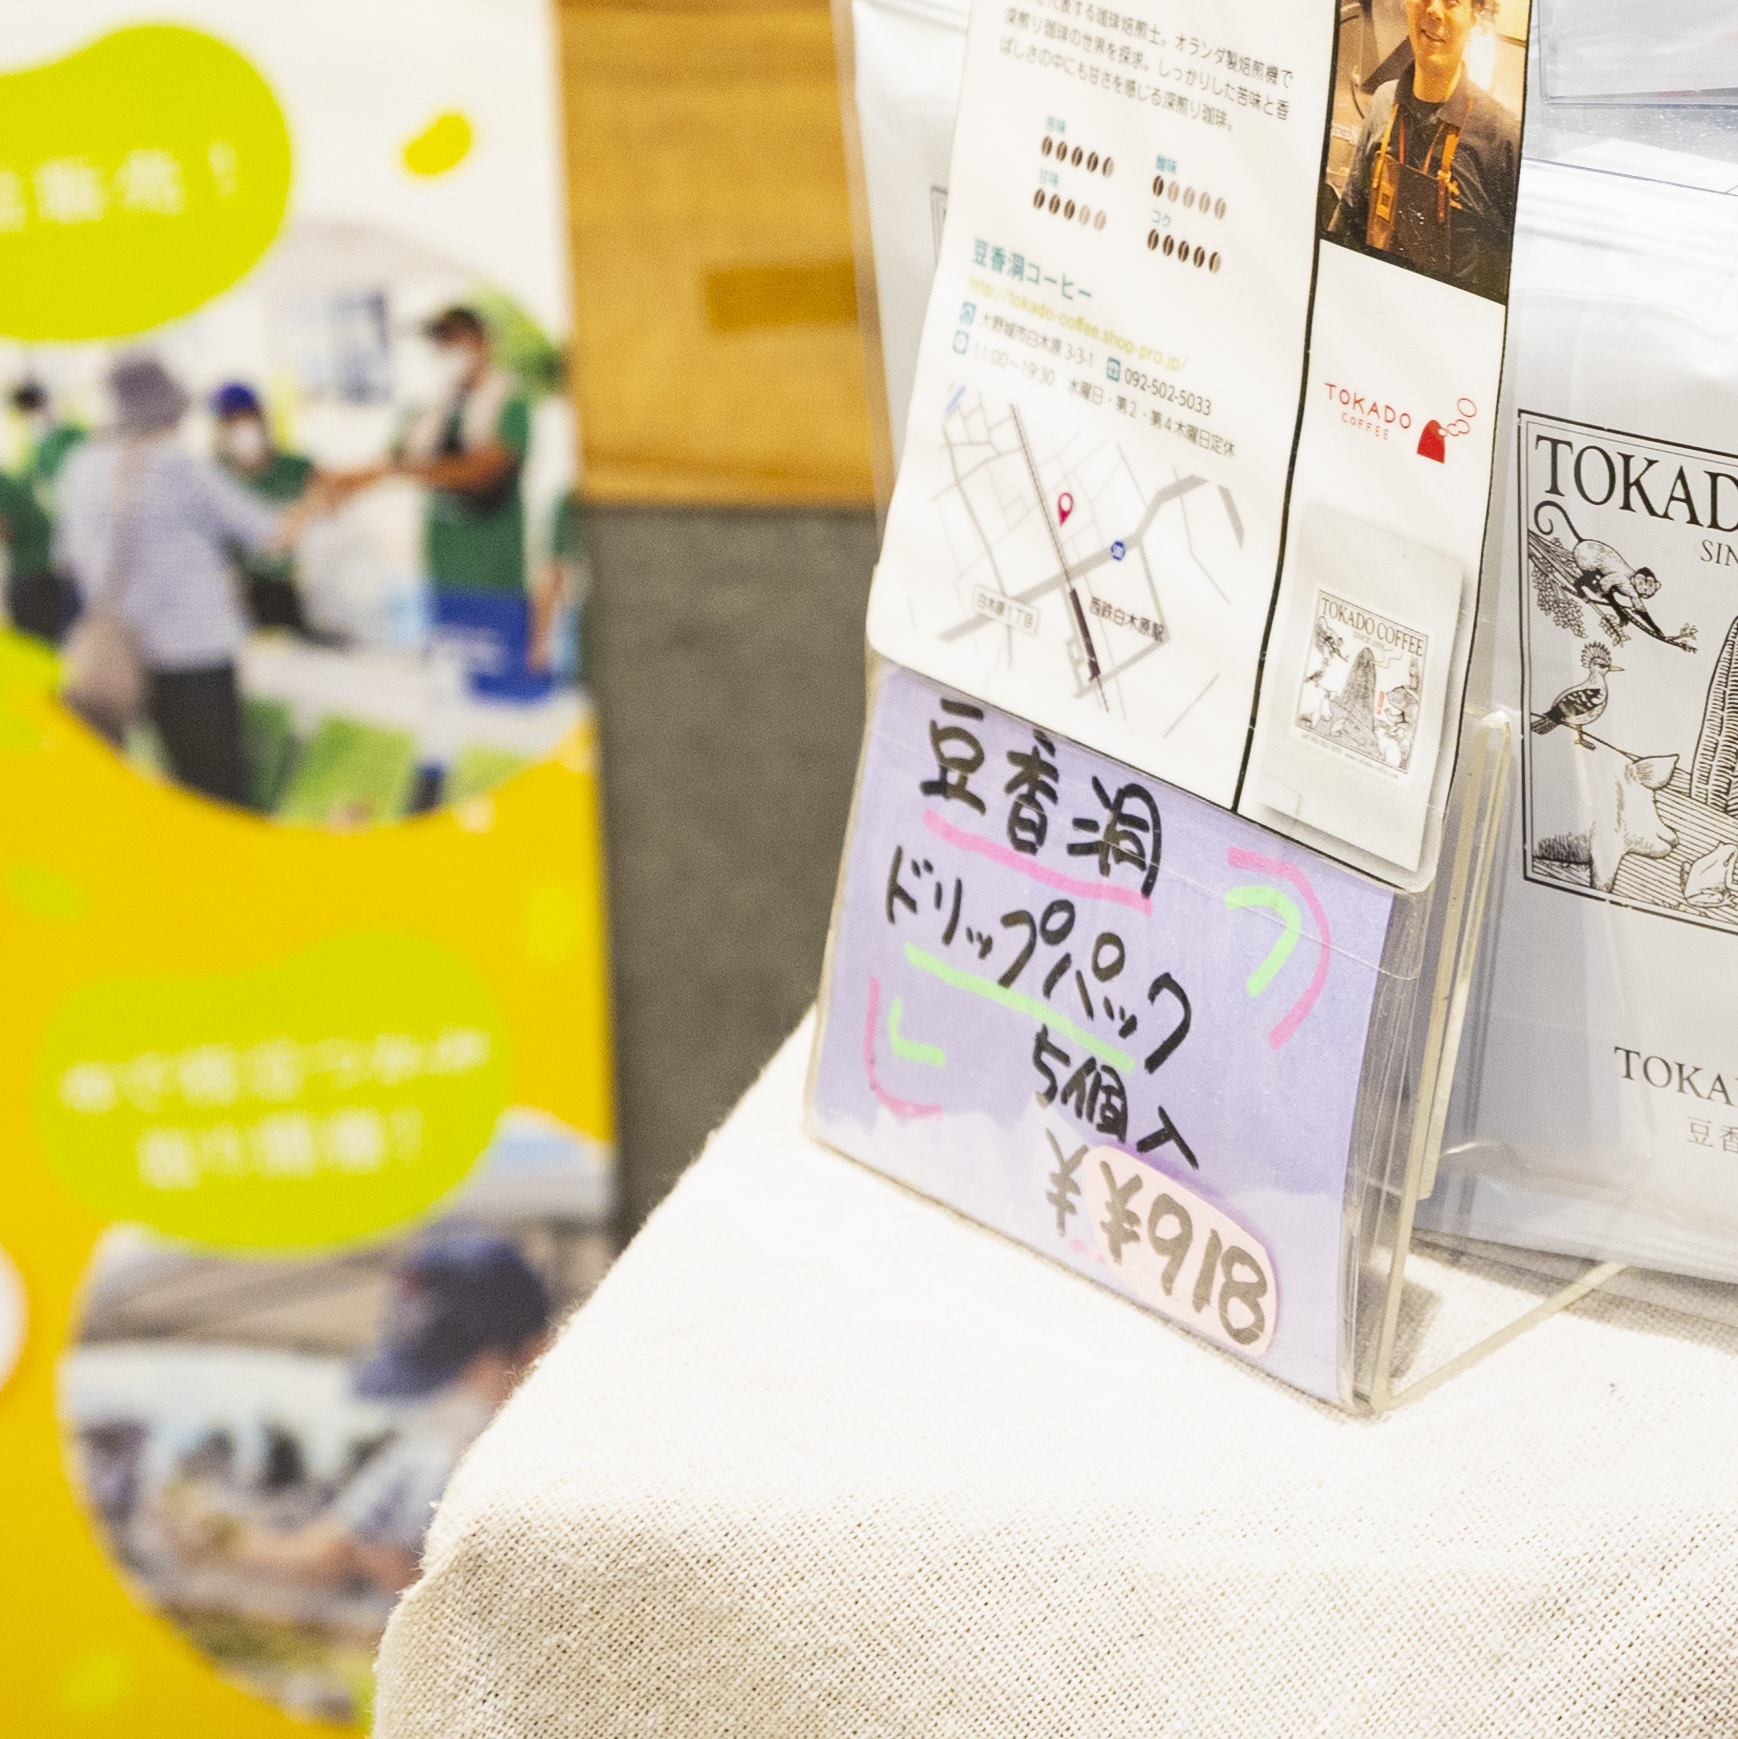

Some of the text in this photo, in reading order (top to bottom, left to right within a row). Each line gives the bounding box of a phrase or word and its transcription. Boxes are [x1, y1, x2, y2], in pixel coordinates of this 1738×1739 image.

[1125, 367, 1211, 417] 092-502-5033
[1324, 383, 1412, 429] TOKADO
[1341, 412, 1390, 440] COFFEE
[1322, 597, 1375, 635] TOKADO
[1377, 623, 1423, 656] COFFEE
[920, 698, 1162, 900] 豆香洞
[885, 845, 1192, 1075] ドリップパック
